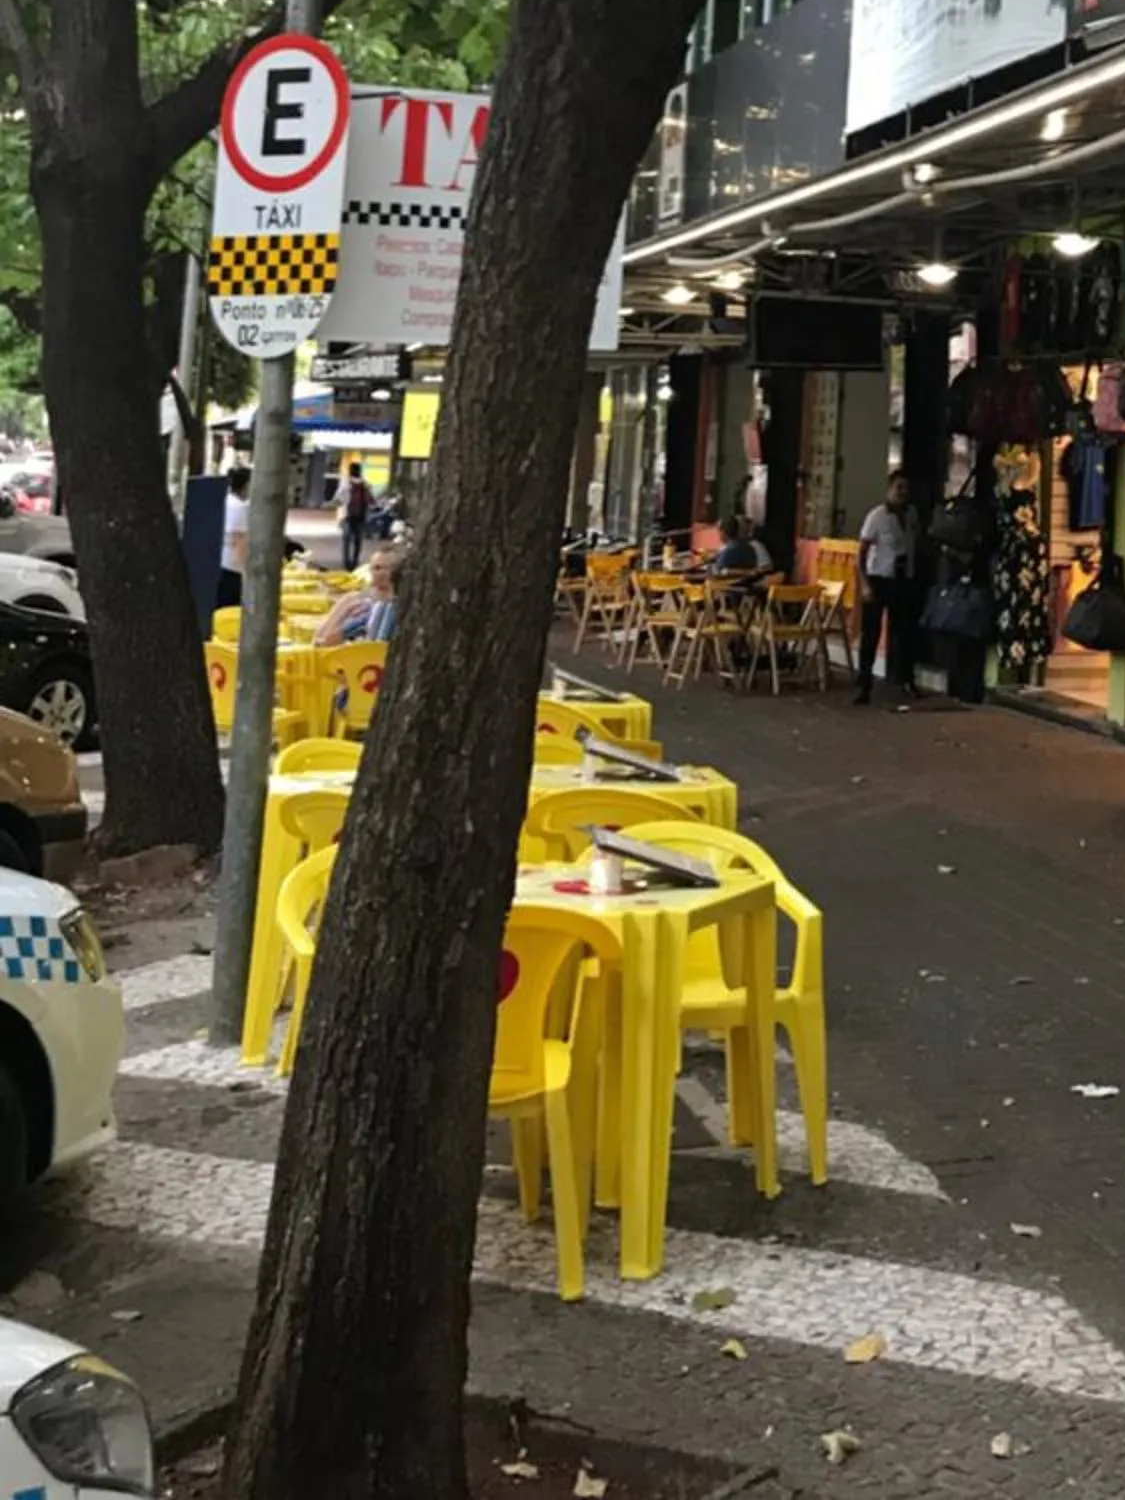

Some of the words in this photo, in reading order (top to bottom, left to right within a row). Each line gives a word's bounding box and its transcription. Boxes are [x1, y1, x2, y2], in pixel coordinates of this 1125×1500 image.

[260, 67, 311, 157] E
[253, 199, 303, 229] TÁXI
[220, 301, 267, 320] Ponto
[237, 324, 260, 347] 02
